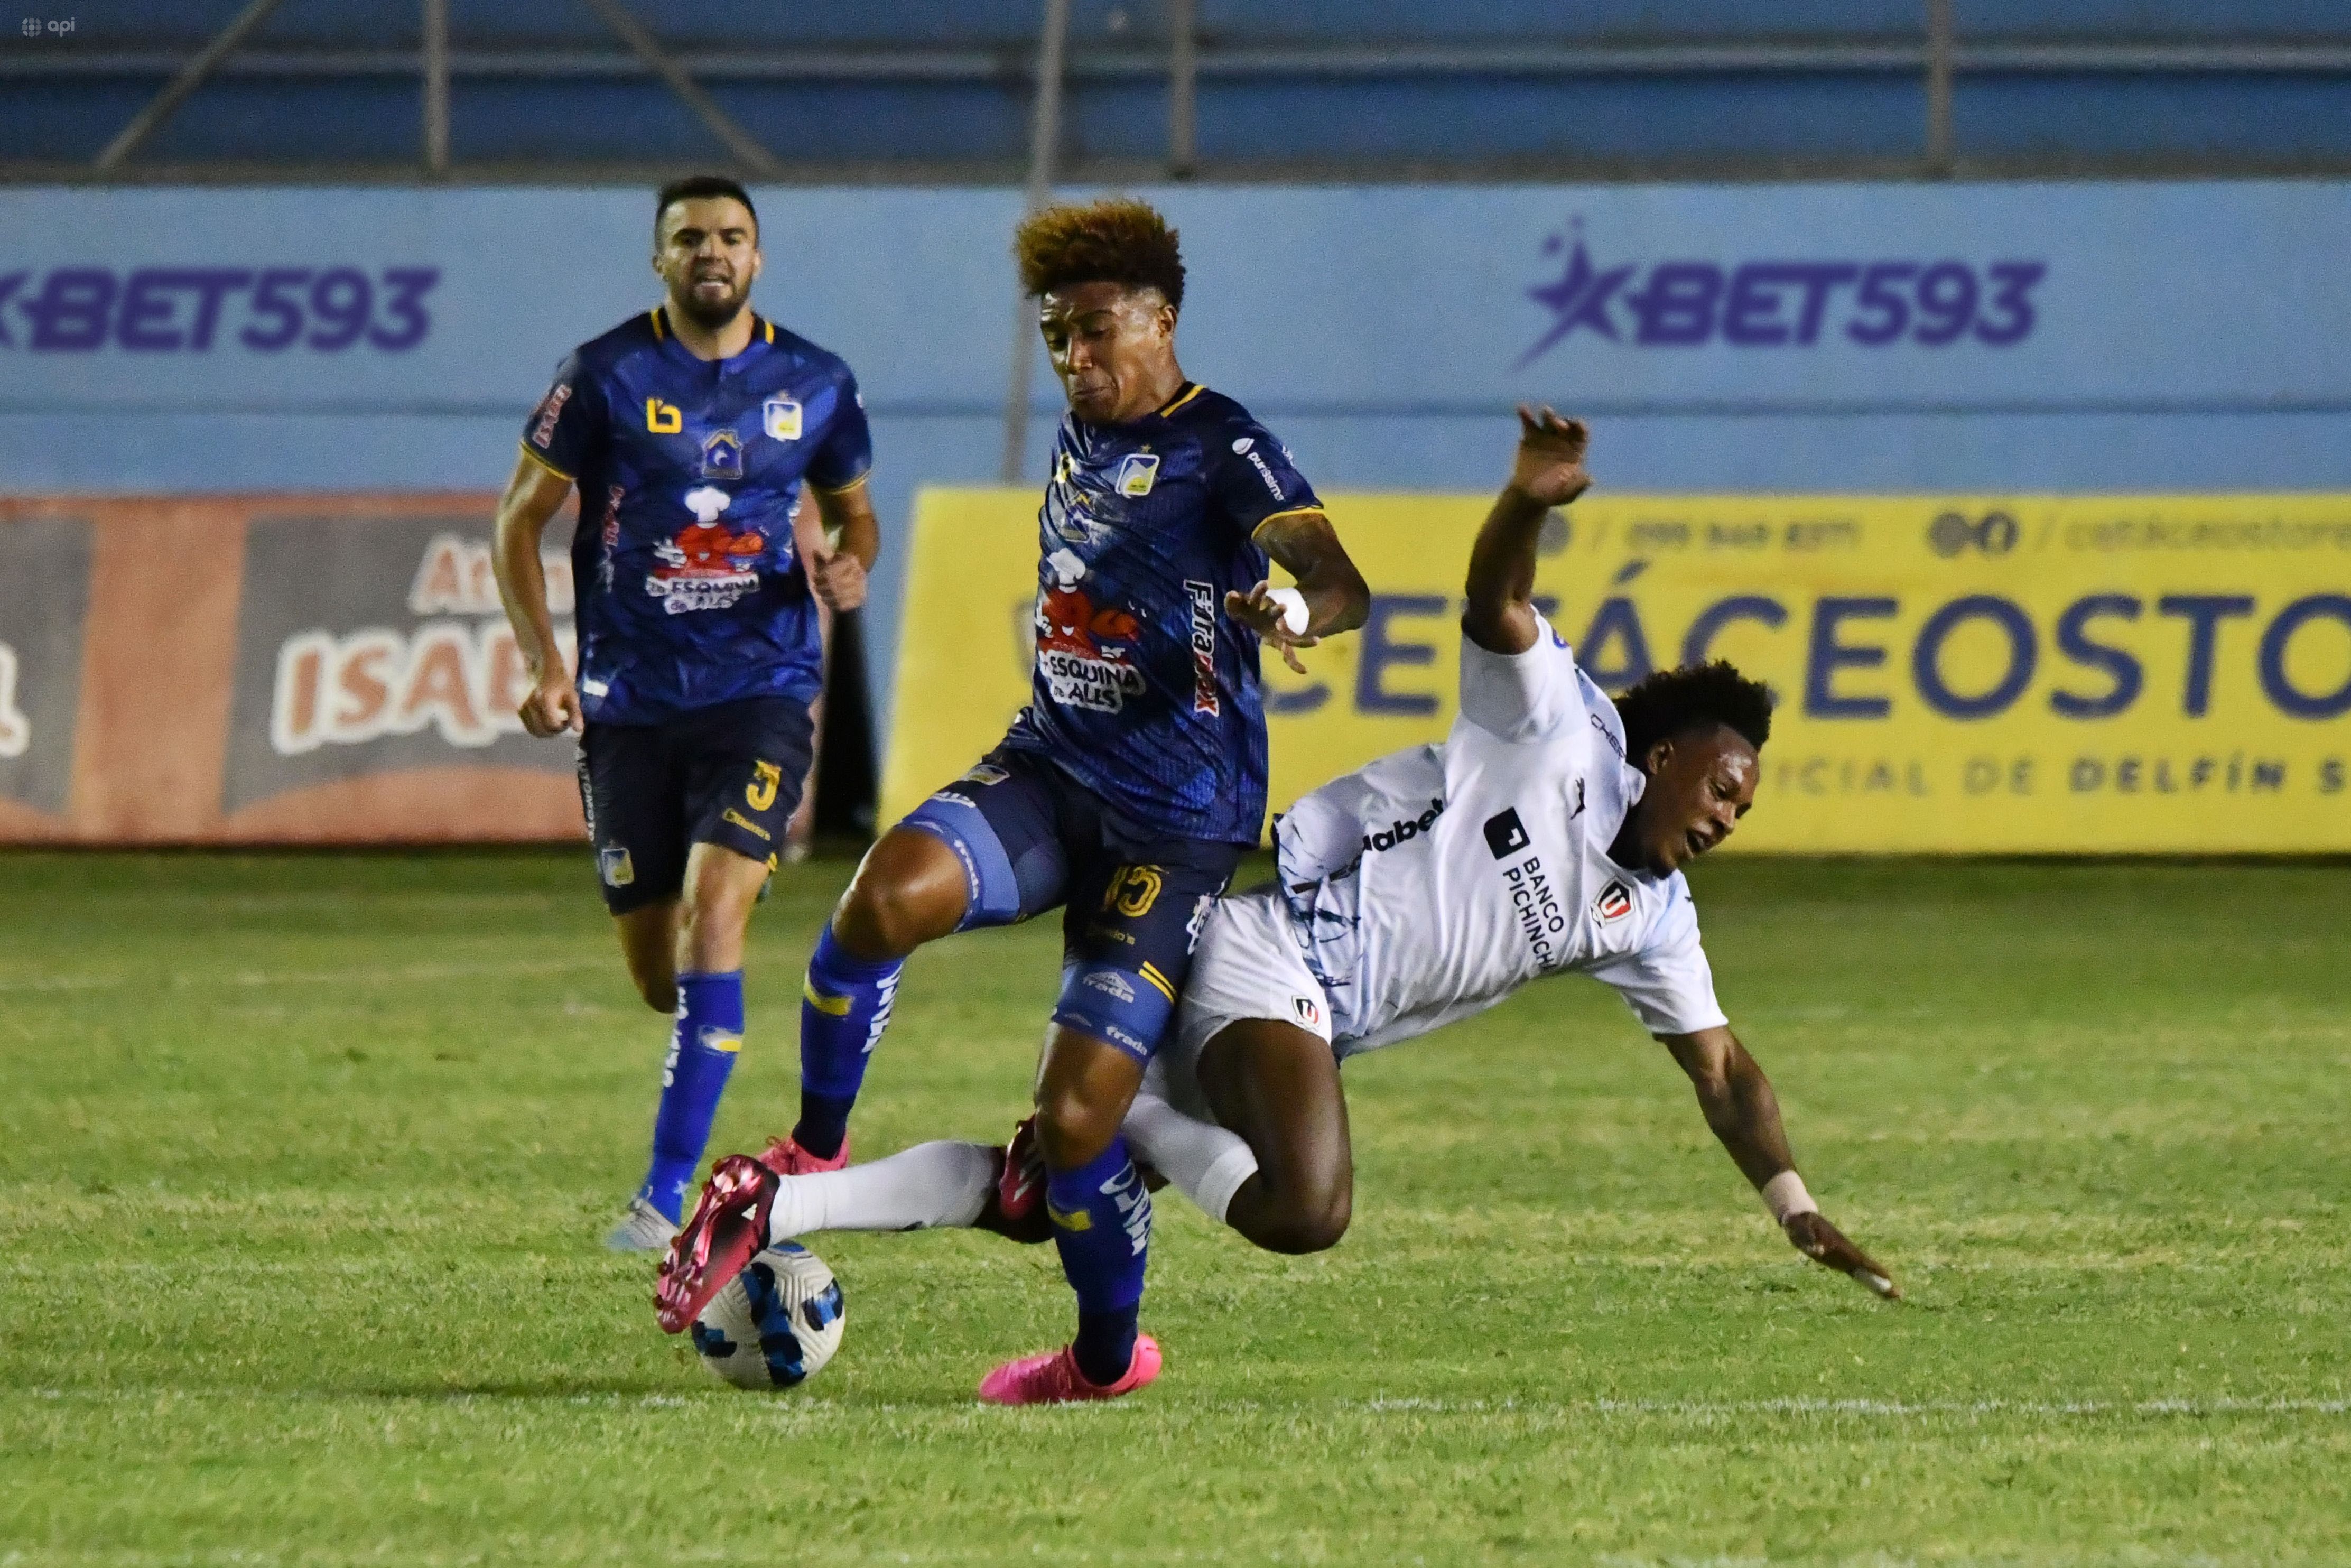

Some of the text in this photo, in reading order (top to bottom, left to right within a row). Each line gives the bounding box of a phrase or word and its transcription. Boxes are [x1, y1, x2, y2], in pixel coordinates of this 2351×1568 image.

[1624, 262, 2049, 347] BET593
[1050, 656, 1139, 688] ESQUINA
[746, 760, 782, 812] 5
[1770, 756, 1934, 797] ICIAL
[2068, 749, 2287, 795] DELFÍN
[1103, 865, 1163, 918] 15
[1523, 856, 1564, 933] BANCO
[1502, 867, 1558, 970] PICHINCH
